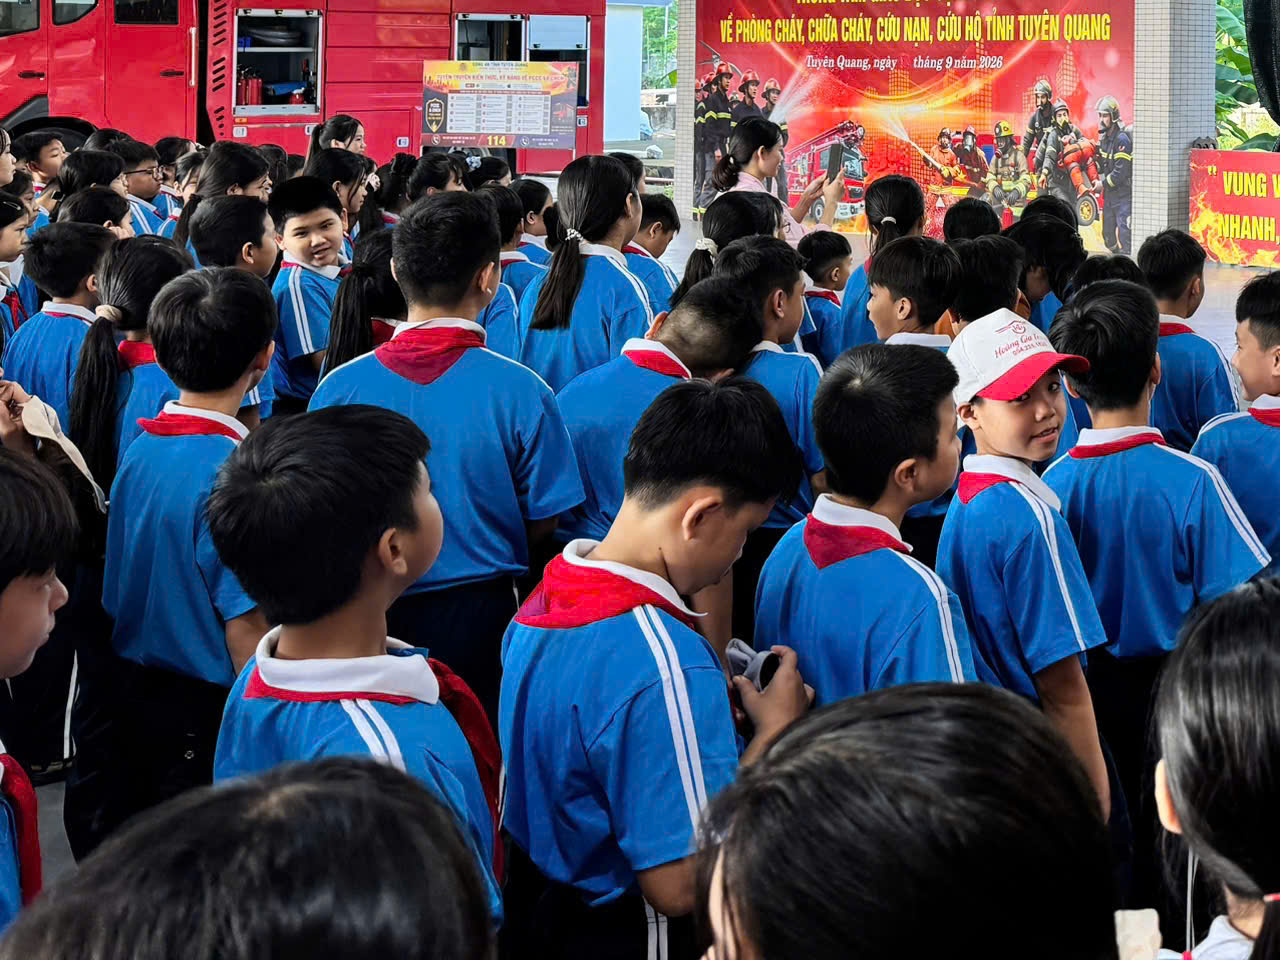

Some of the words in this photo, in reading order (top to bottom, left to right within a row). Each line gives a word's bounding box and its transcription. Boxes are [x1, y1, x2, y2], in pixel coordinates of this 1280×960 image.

[720, 12, 733, 43] VỀ
[735, 14, 772, 43] PHÒNG
[775, 14, 805, 44] CHÁY,
[808, 13, 838, 42] CHỮA
[841, 12, 873, 44] CHÁY,
[876, 11, 901, 42] CỨU
[903, 16, 933, 47] NẠN,
[936, 11, 962, 42] CỨU
[965, 10, 982, 47] HỘ
[985, 7, 1015, 41] TỈNH
[1018, 9, 1060, 41] TUYÊN
[1064, 13, 1111, 44] QUANG
[806, 55, 835, 71] Tuyên
[836, 55, 871, 70] Quang,
[873, 55, 897, 71] ngày
[913, 55, 943, 71] tháng
[945, 56, 953, 69] 9
[954, 55, 977, 68] năm
[979, 56, 1003, 69] 2026
[487, 135, 506, 146] 114
[1223, 171, 1268, 198] VUNG
[1217, 213, 1280, 245] NHANH,
